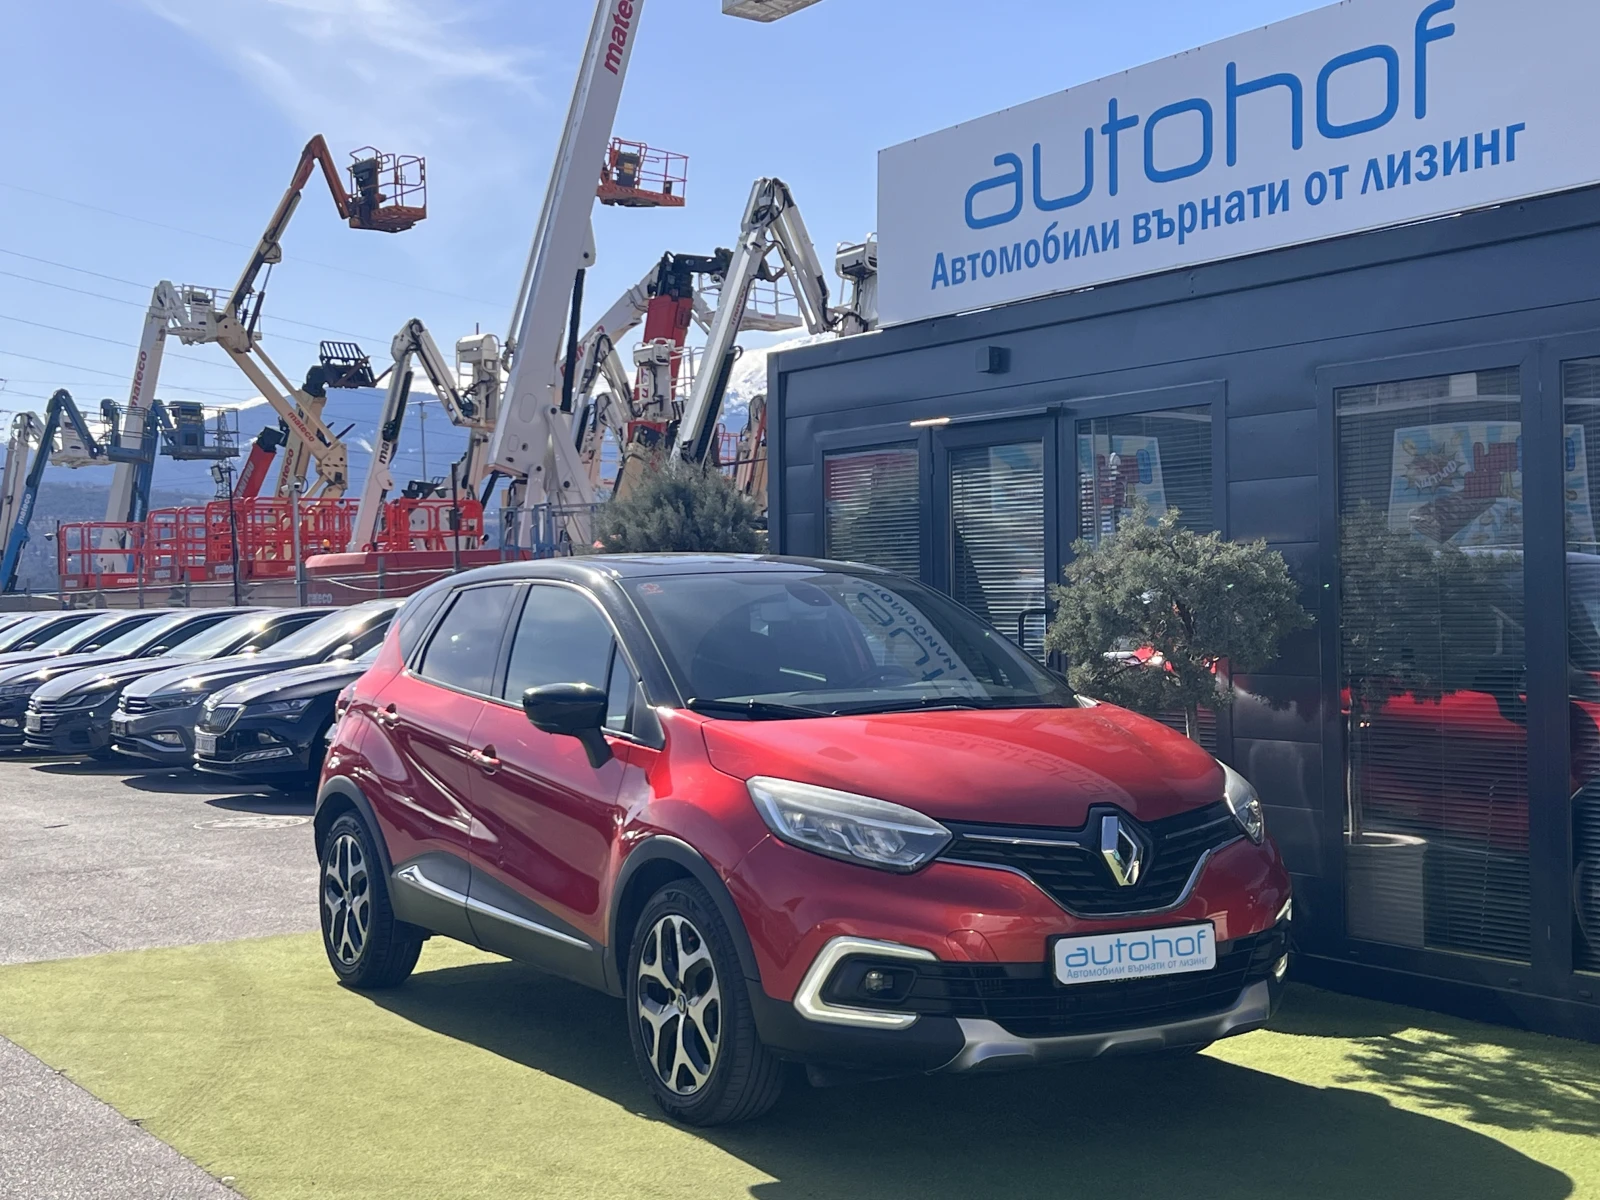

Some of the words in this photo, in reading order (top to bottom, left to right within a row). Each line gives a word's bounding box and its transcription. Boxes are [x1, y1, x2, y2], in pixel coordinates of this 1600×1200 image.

[604, 0, 634, 75] mate
[964, 0, 1456, 230] autohof
[931, 217, 1120, 290] Автомобили
[1132, 178, 1290, 247] върнати
[1303, 163, 1351, 207] от
[1360, 121, 1527, 196] лизинг
[287, 411, 315, 442] mateco
[235, 460, 255, 498] ANITOU
[17, 493, 32, 525] mateco
[1064, 929, 1207, 968] autohof
[1066, 965, 1125, 979] Автомобили
[1127, 961, 1166, 974] върнати
[1167, 959, 1178, 969] от
[1179, 956, 1209, 968] лизинг
